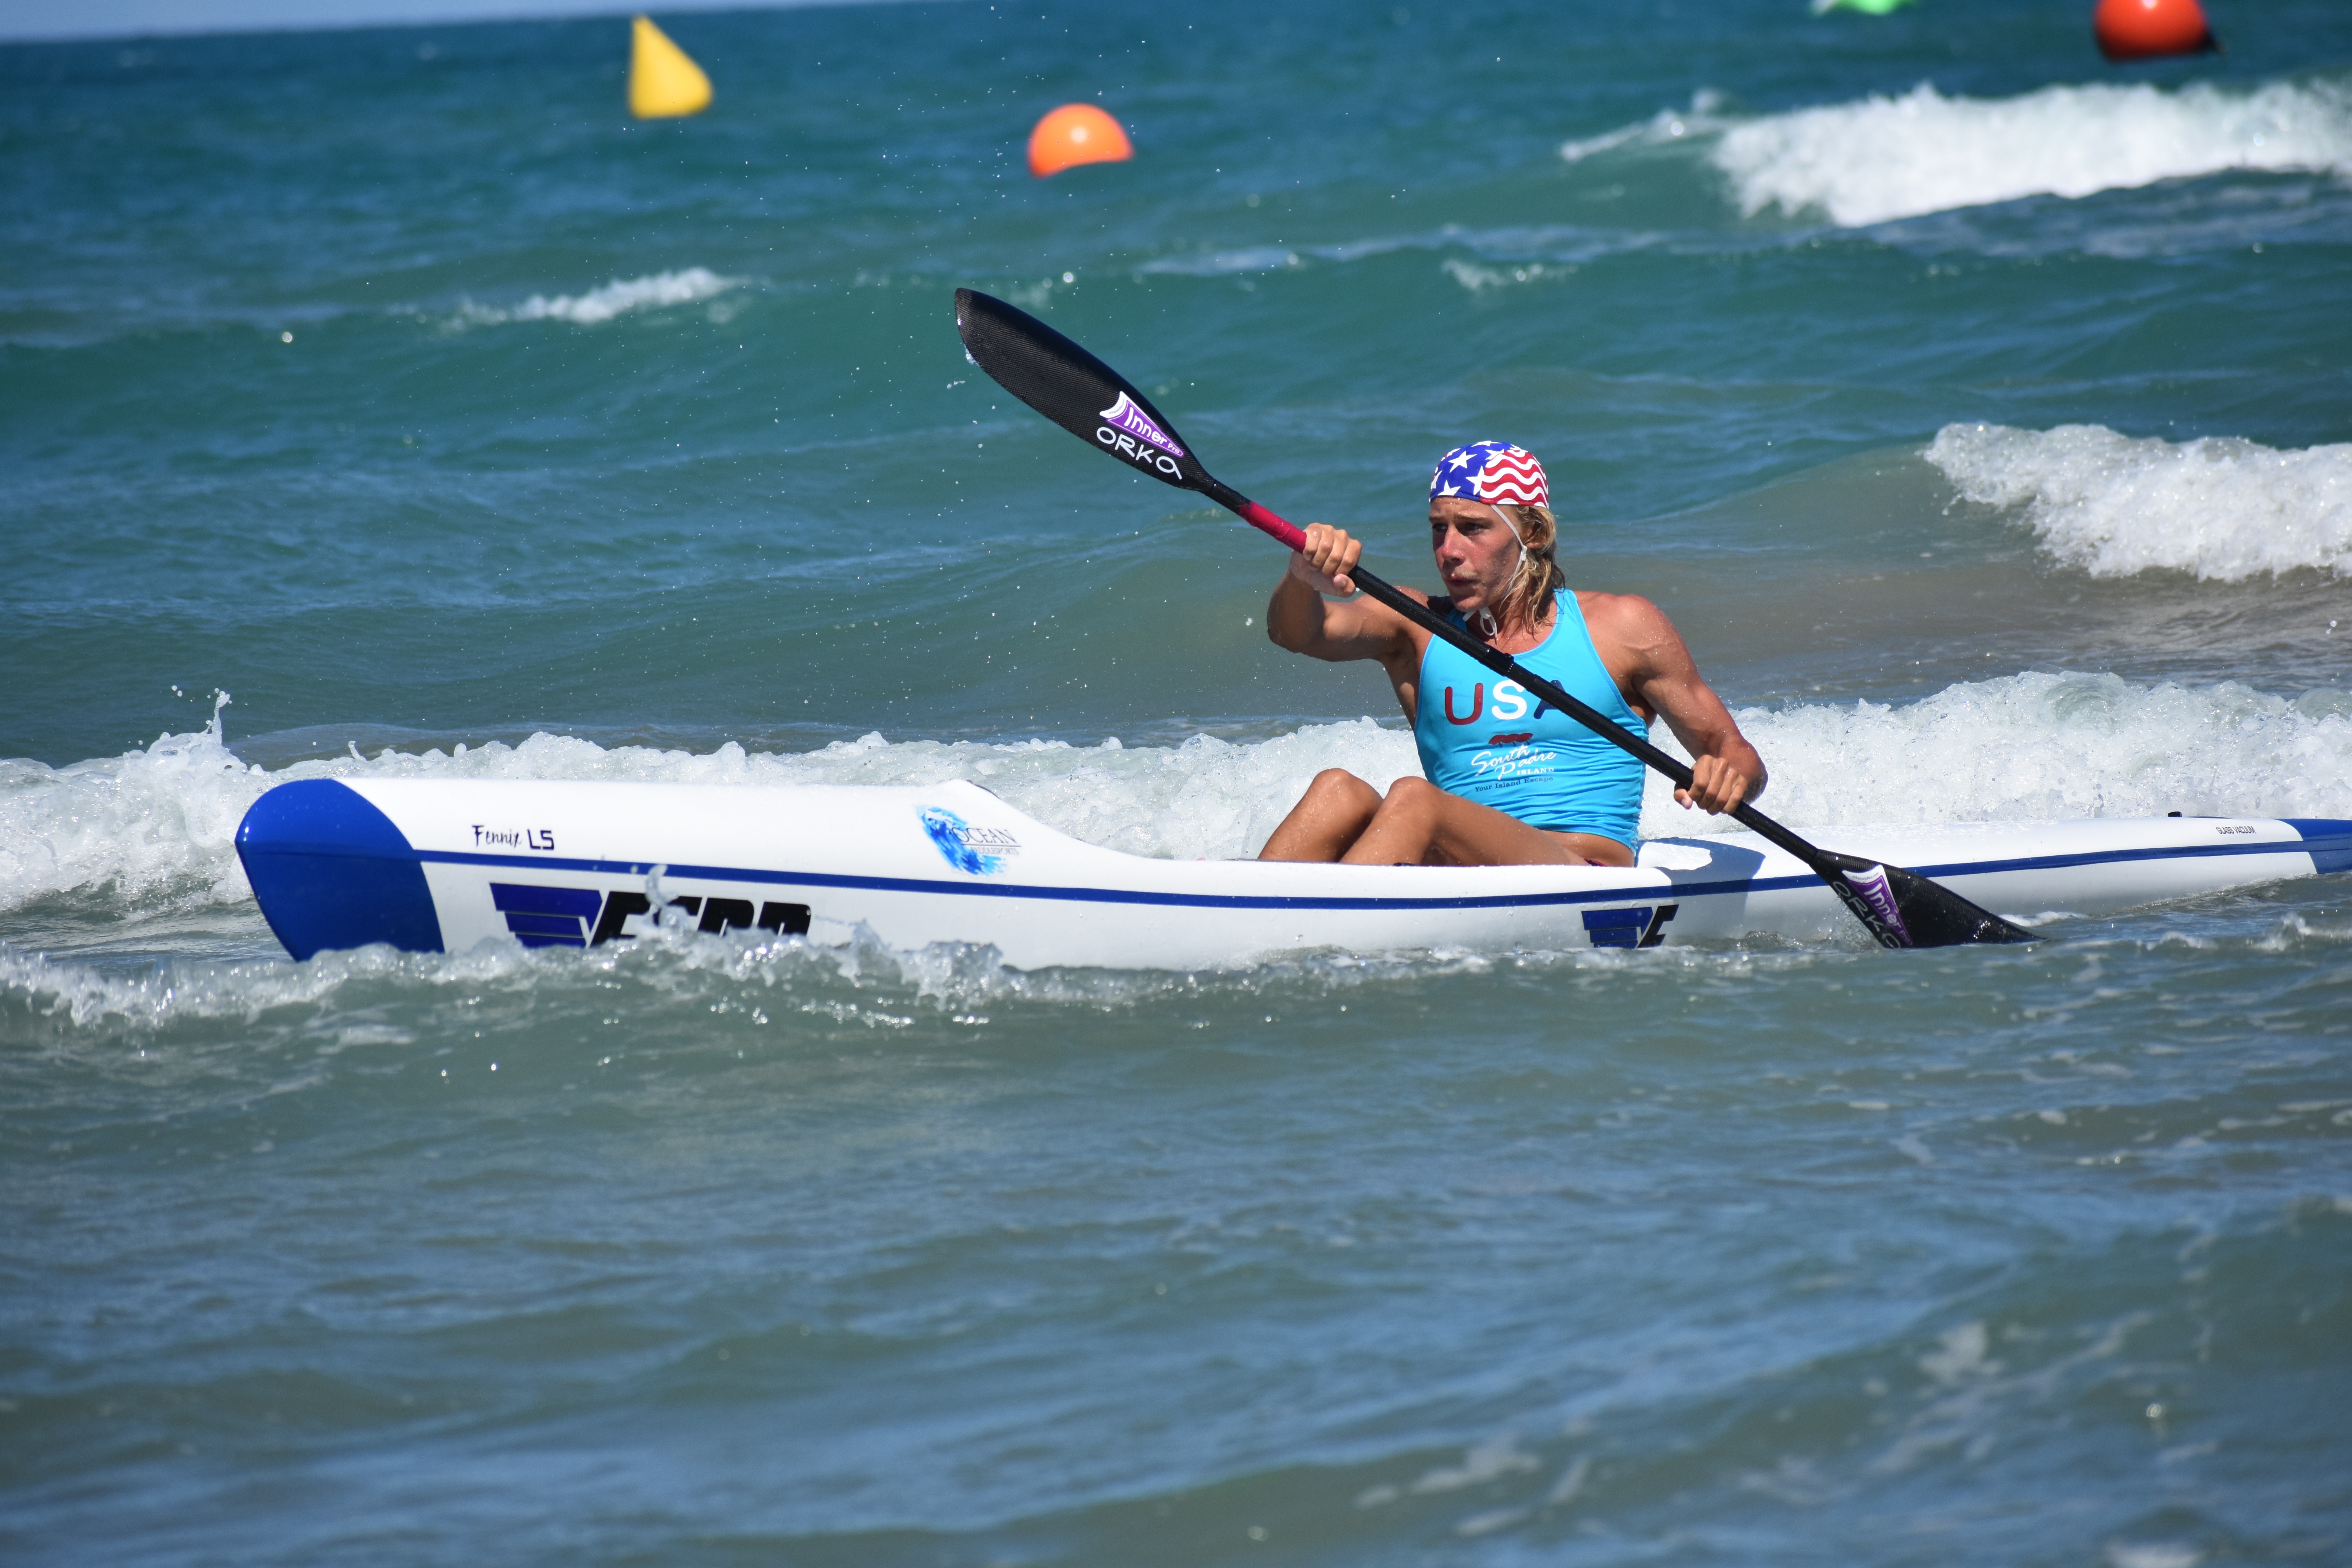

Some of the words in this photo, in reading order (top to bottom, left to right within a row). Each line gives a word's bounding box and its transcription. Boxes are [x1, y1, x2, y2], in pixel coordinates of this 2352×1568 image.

[1123, 407, 1167, 444] Inner
[1167, 443, 1180, 454] Pro
[1471, 743, 1530, 777] South
[1494, 749, 1557, 780] Padre
[1495, 780, 1521, 789] Island
[472, 825, 523, 848] Fennix
[527, 829, 555, 850] LS
[951, 827, 1017, 844] OCEAN
[970, 847, 1020, 855] PADDLESPORTS
[1864, 883, 1902, 928] Inner
